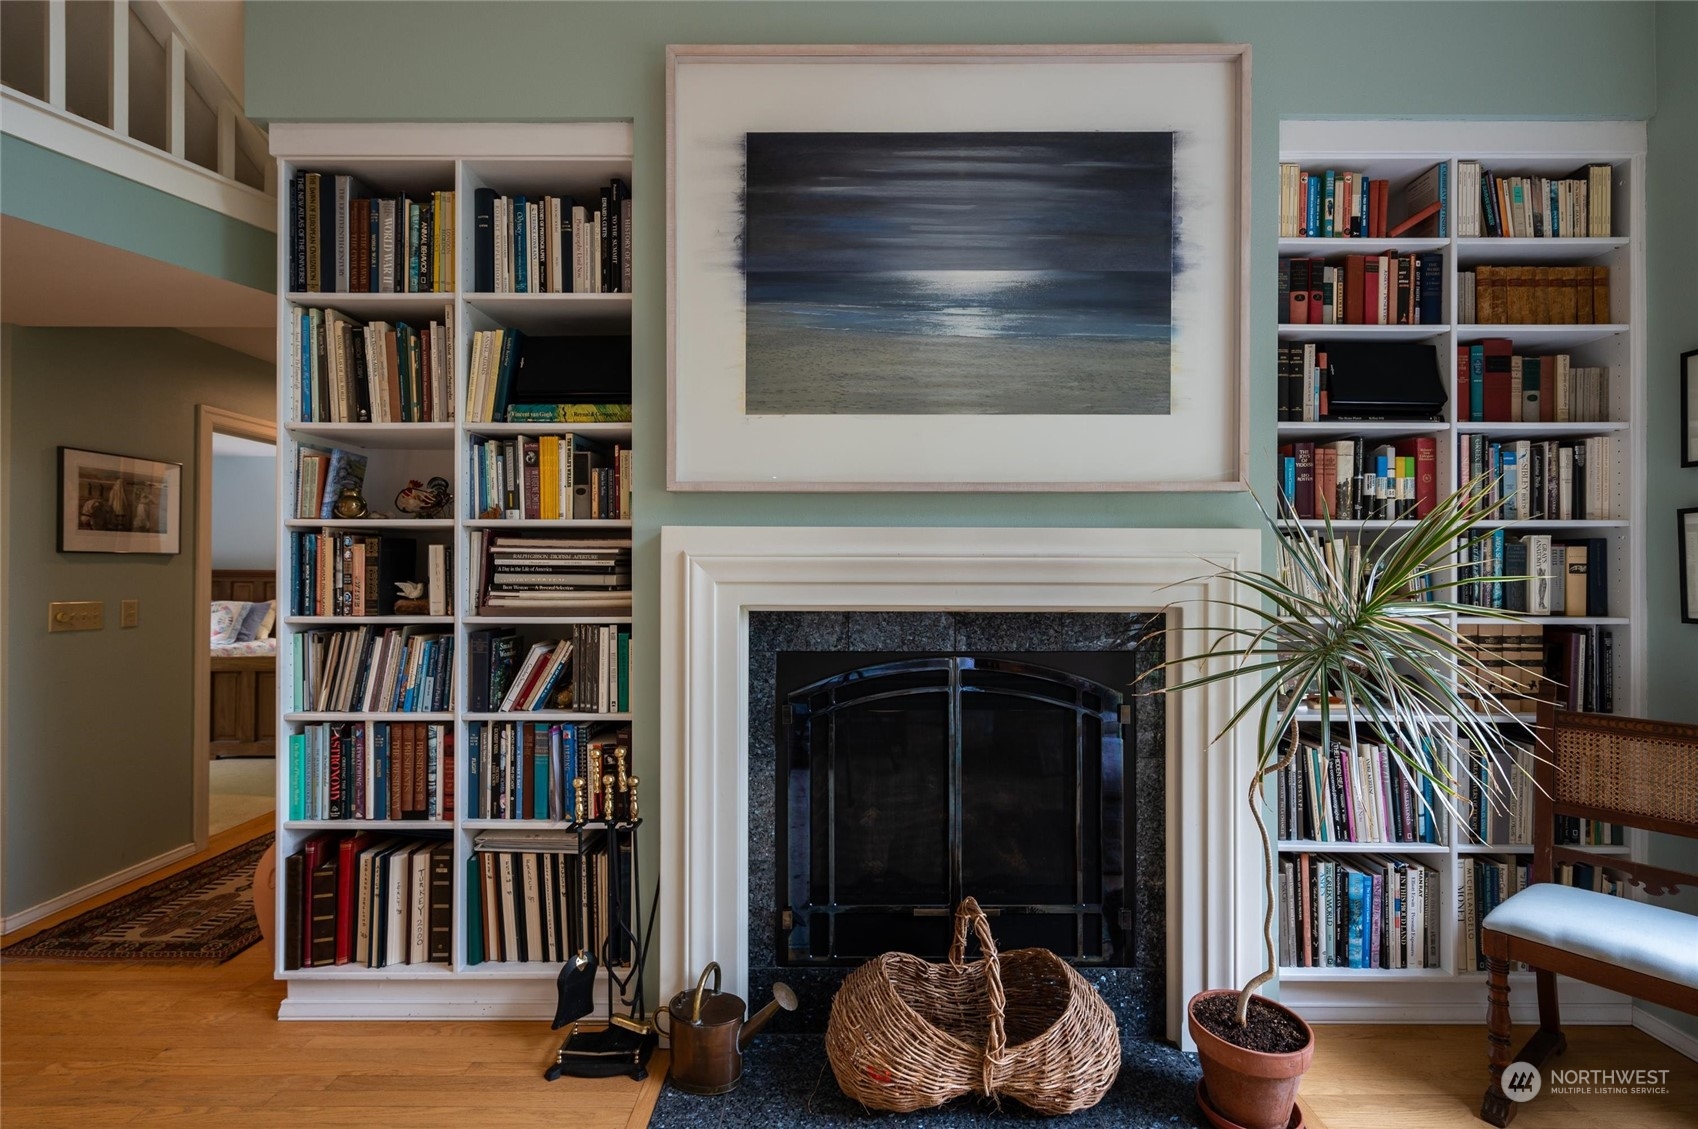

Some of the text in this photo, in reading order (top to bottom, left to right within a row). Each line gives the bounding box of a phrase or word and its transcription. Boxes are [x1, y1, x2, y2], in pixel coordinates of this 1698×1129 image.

[612, 215, 617, 223] TO
[298, 229, 304, 237] OF
[383, 218, 392, 251] WORLD
[383, 253, 392, 274] WAR
[625, 252, 630, 260] OF
[331, 735, 340, 800] ASTRONOMY
[392, 760, 400, 810] PRESIDENCY
[1331, 793, 1339, 821] photographer
[1401, 875, 1406, 884] IN
